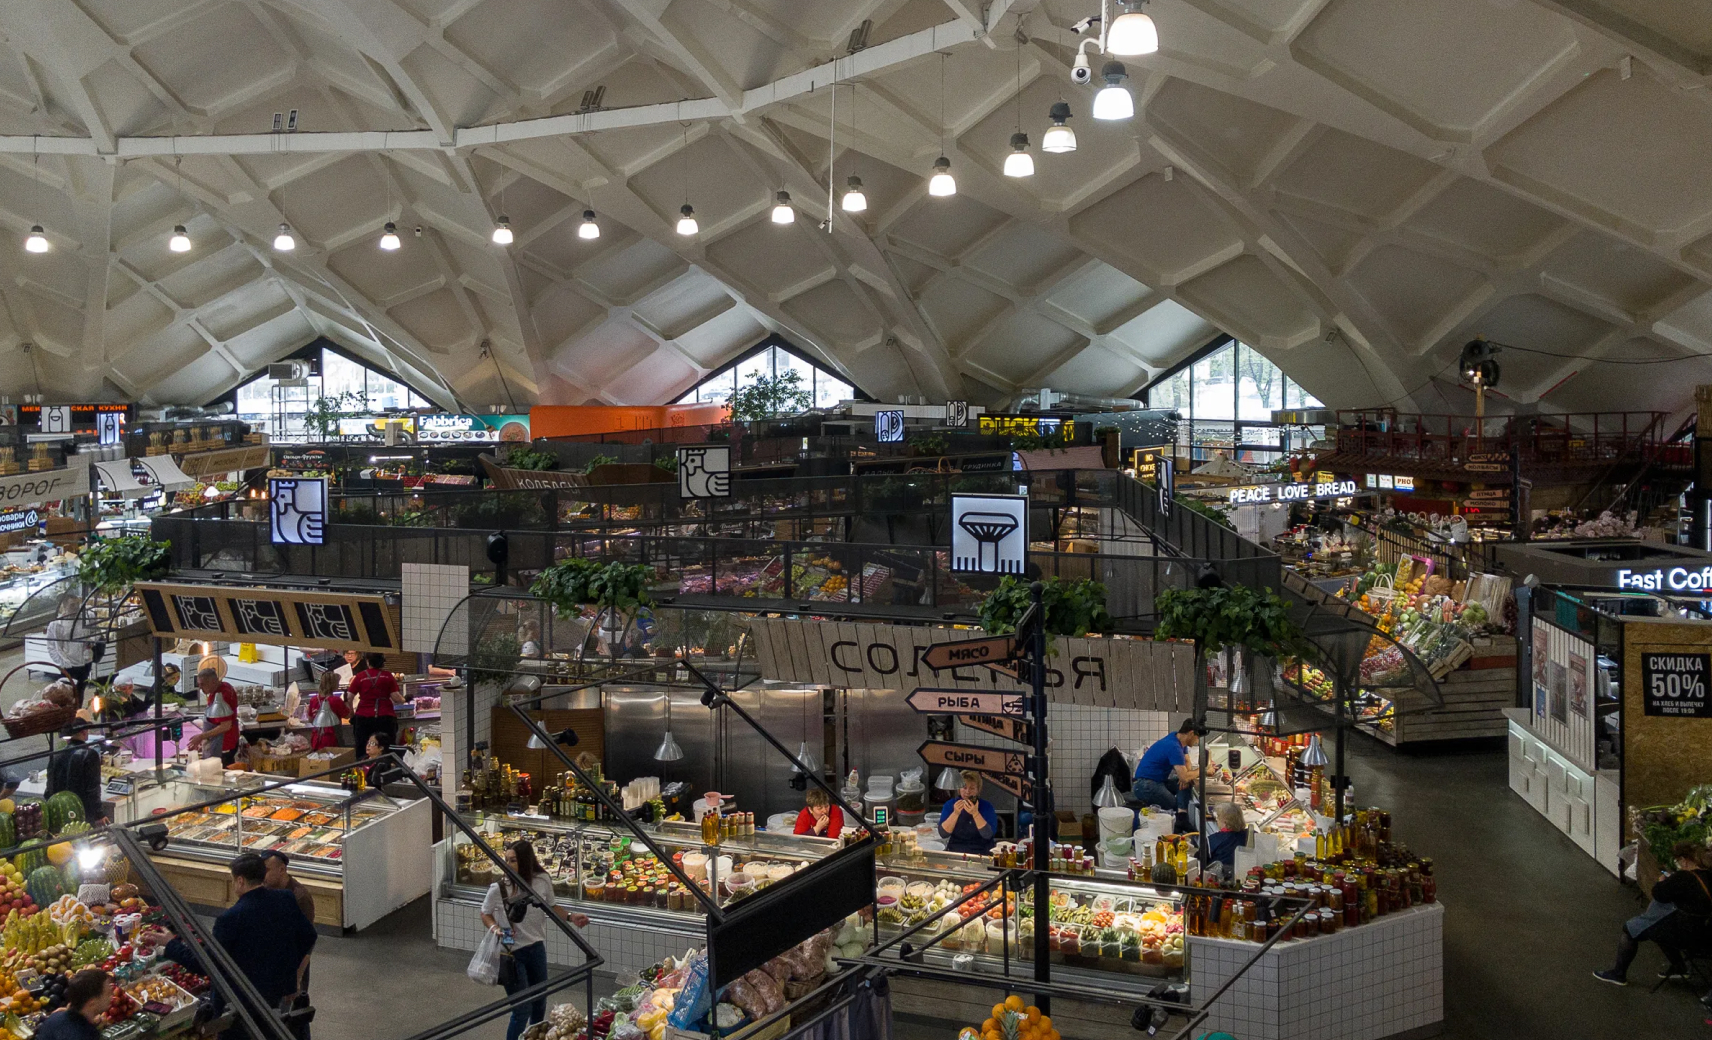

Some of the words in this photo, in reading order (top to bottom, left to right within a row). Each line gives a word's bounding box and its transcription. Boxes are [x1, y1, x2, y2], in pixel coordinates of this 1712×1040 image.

[419, 415, 473, 427] Fabbrica
[1230, 488, 1270, 503] PEACE
[1278, 484, 1308, 500] LOVE
[1317, 480, 1357, 497] BREAD
[1619, 569, 1664, 590] Fast
[948, 646, 990, 661] МЯСО
[1650, 656, 1703, 672] СКИДКА
[1651, 673, 1705, 699] 50%
[938, 697, 981, 709] РЫБА
[944, 751, 985, 766] СЫРЫ
